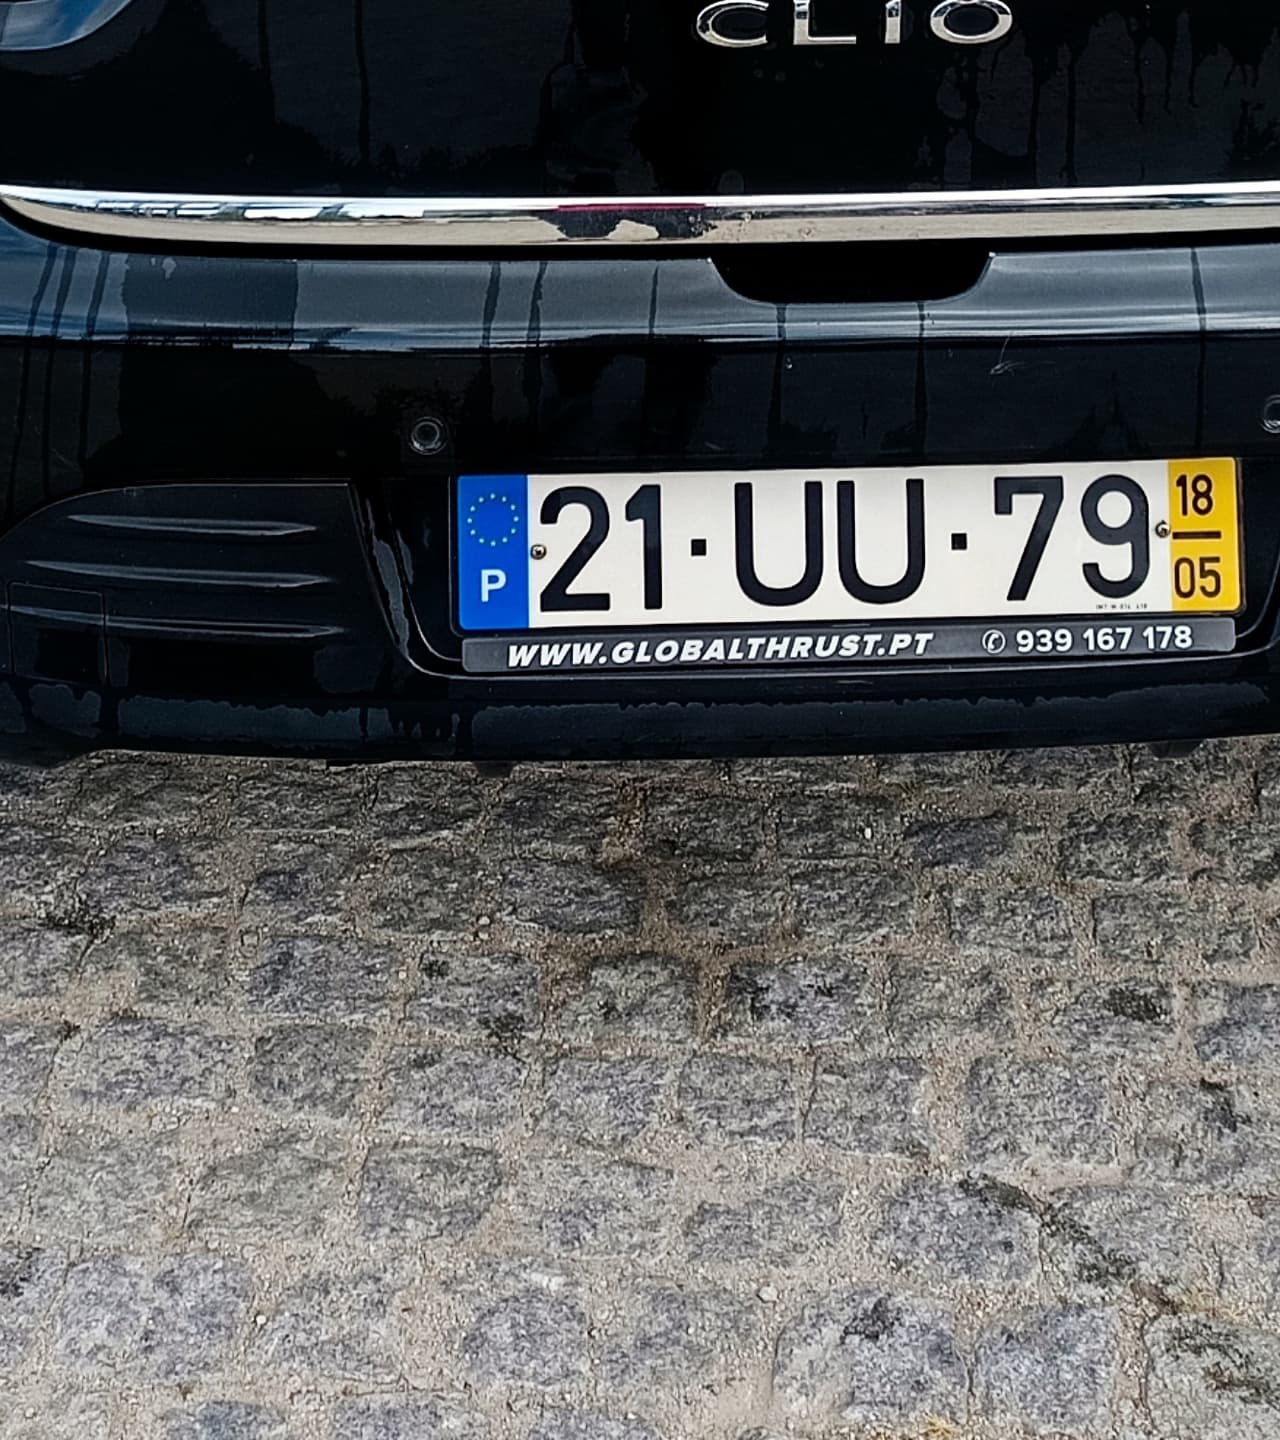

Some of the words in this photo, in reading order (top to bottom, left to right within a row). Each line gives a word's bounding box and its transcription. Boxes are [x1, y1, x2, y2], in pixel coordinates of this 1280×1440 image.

[1176, 474, 1214, 516] 18
[480, 569, 507, 602] P
[1174, 556, 1221, 599] 05
[508, 633, 934, 667] WWW.GLOBALTHRUST.PT
[1016, 629, 1073, 653] 939
[1083, 627, 1133, 651] 167
[1143, 625, 1193, 650] 178
